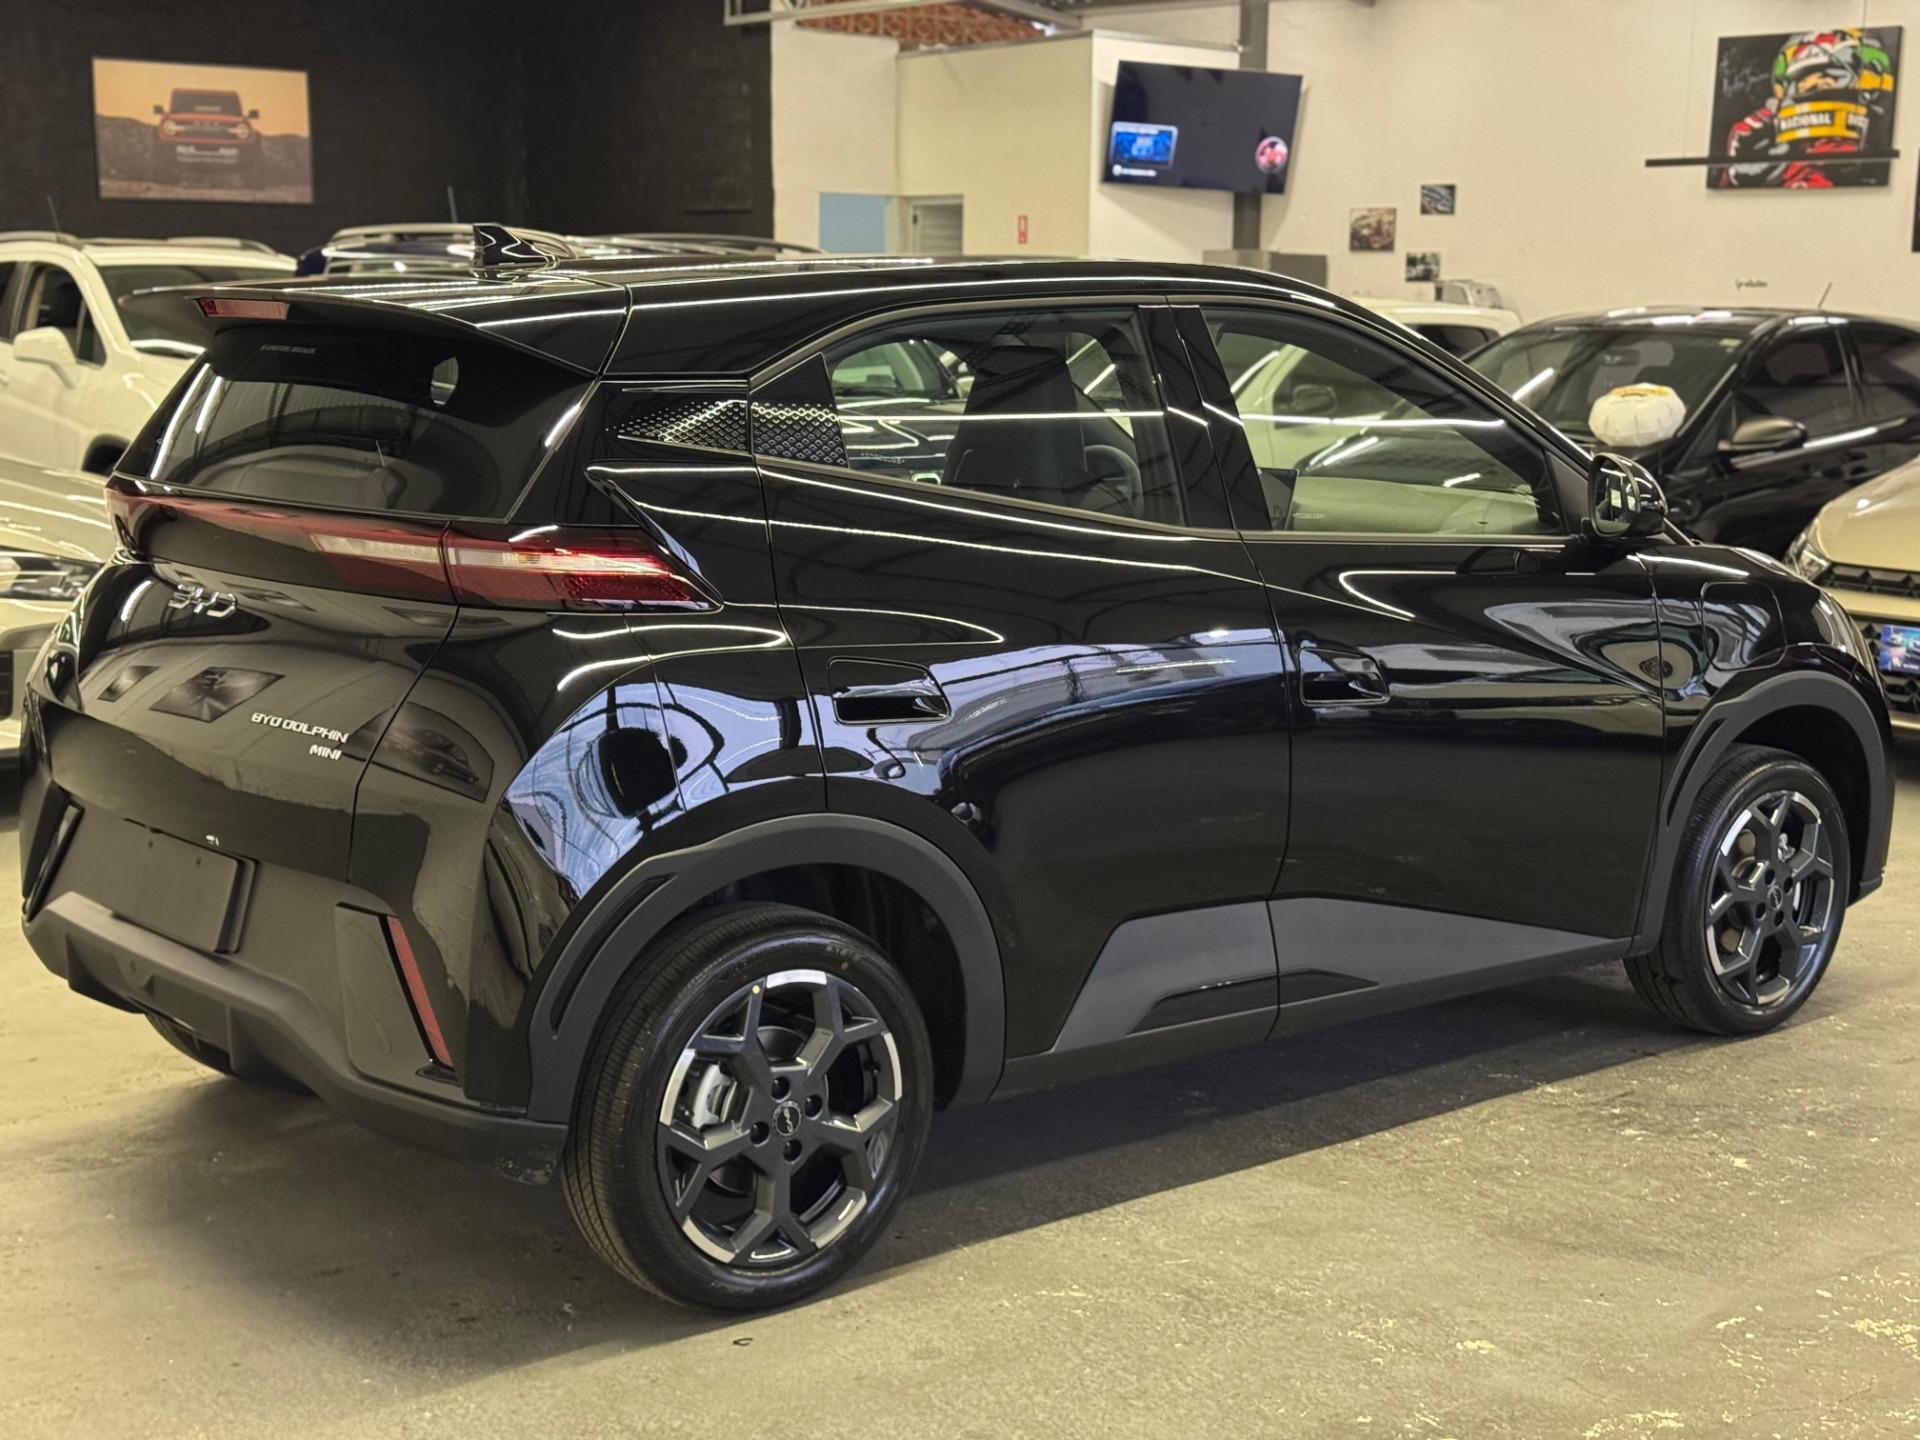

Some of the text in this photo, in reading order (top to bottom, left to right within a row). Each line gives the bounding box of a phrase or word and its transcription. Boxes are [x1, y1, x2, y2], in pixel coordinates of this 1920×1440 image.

[1779, 112, 1832, 131] NACIONAL
[168, 584, 236, 618] BYD
[251, 712, 349, 743] BYD DOLPHIN
[309, 744, 342, 761] MINI
